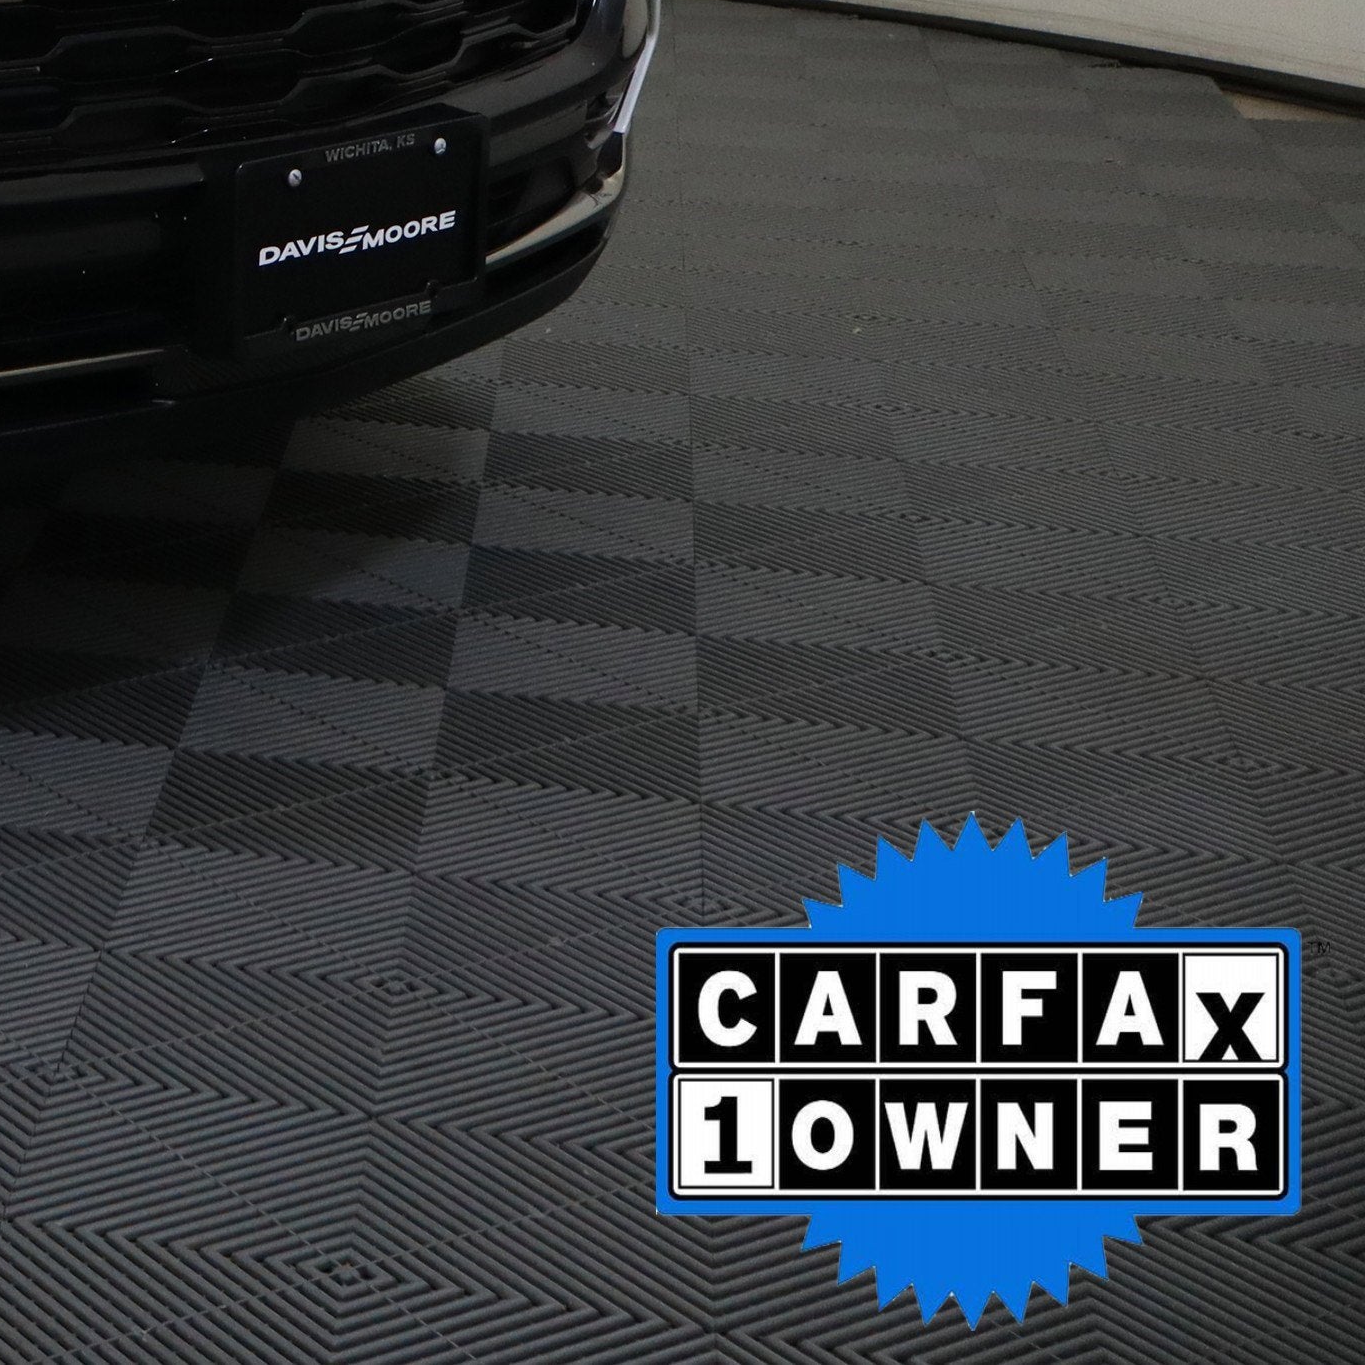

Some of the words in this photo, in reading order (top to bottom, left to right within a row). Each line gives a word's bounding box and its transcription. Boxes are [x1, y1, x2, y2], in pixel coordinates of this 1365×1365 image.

[324, 143, 393, 163] WICHITA,
[396, 133, 416, 147] KS
[258, 231, 346, 267] DAVIS
[362, 210, 456, 251] MOORE
[295, 315, 352, 342] DAVIS
[364, 300, 431, 329] MOORE
